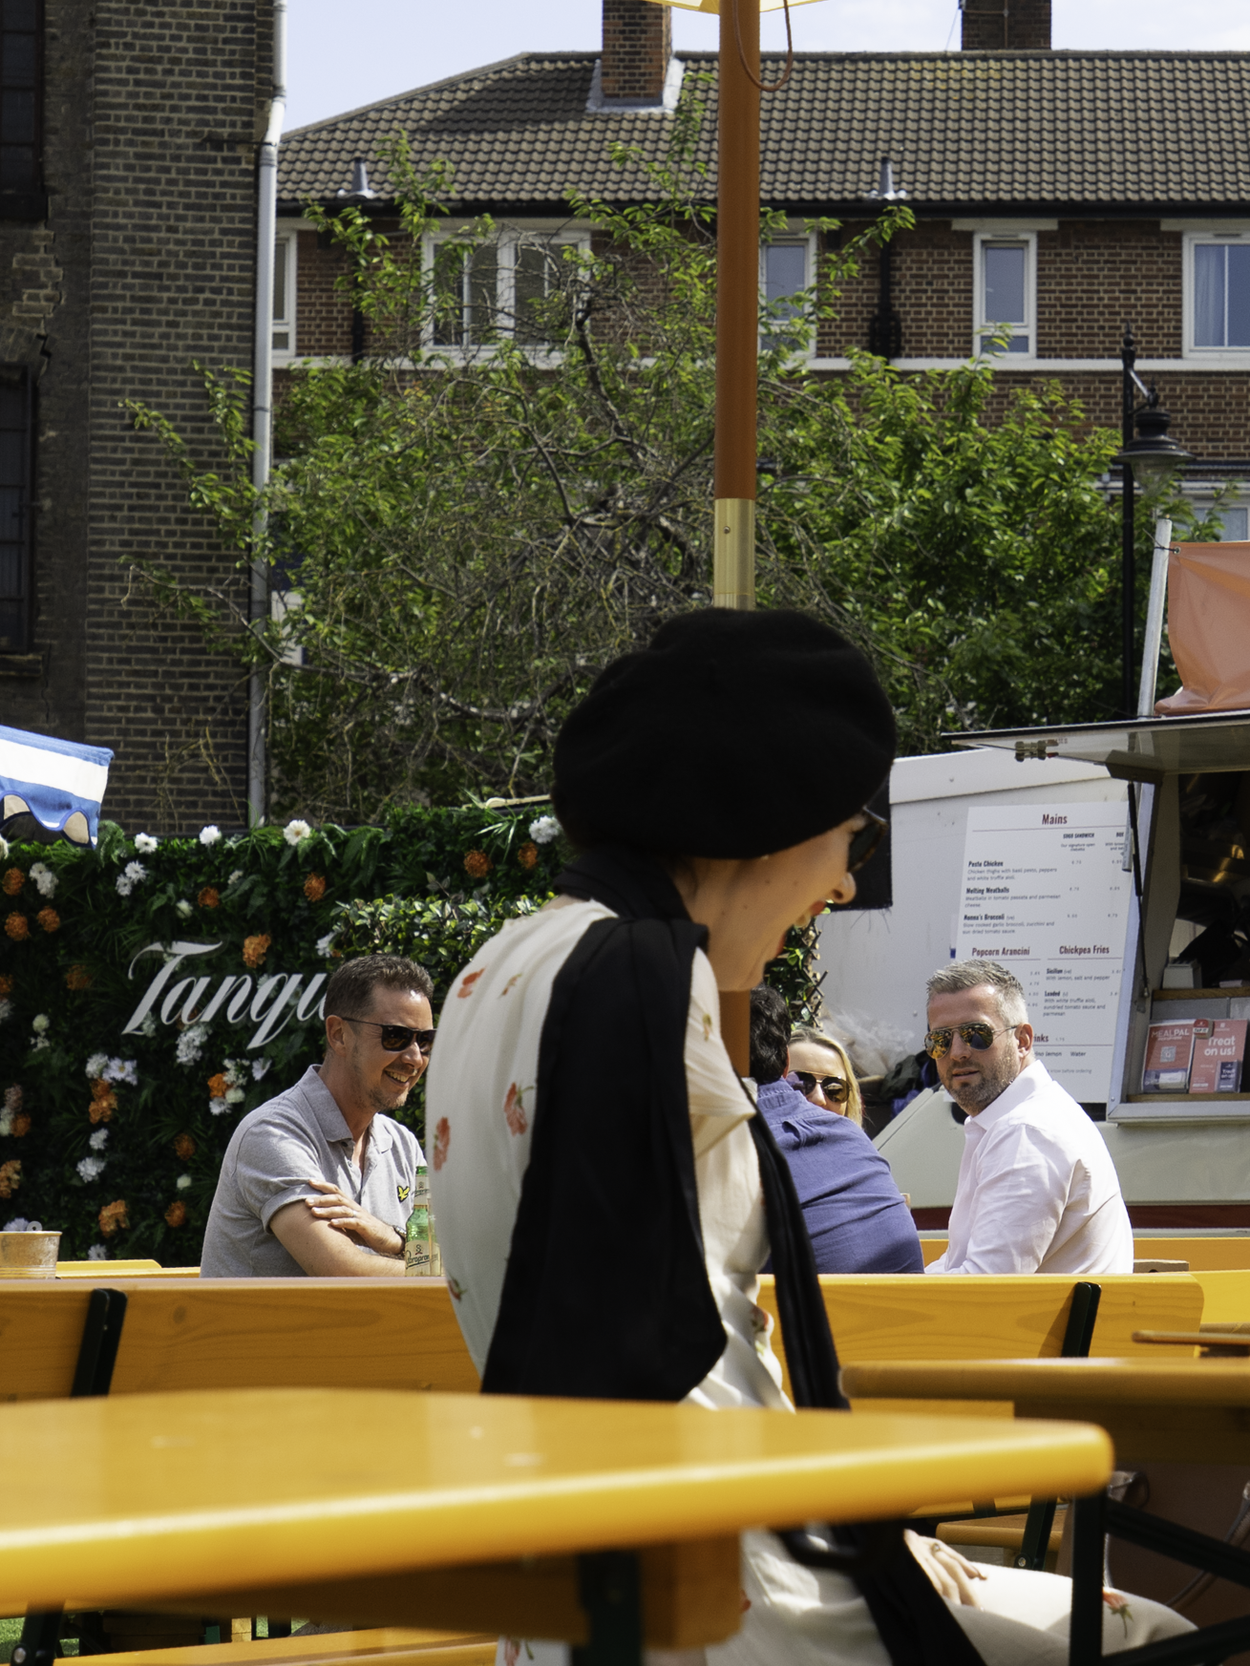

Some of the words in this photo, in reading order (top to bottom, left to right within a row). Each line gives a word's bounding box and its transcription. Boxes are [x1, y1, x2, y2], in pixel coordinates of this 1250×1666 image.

[1042, 813, 1068, 824] Mains
[972, 947, 999, 958] Popcorn
[1001, 946, 1030, 956] Arancini
[1059, 945, 1091, 956] Chickpea
[1093, 945, 1110, 954] Fries
[121, 941, 327, 1050] Tanqu
[1033, 1033, 1049, 1042] inks
[1151, 1028, 1190, 1038] MEALPAL
[1208, 1035, 1235, 1046] Treat
[1220, 1046, 1235, 1056] us!
